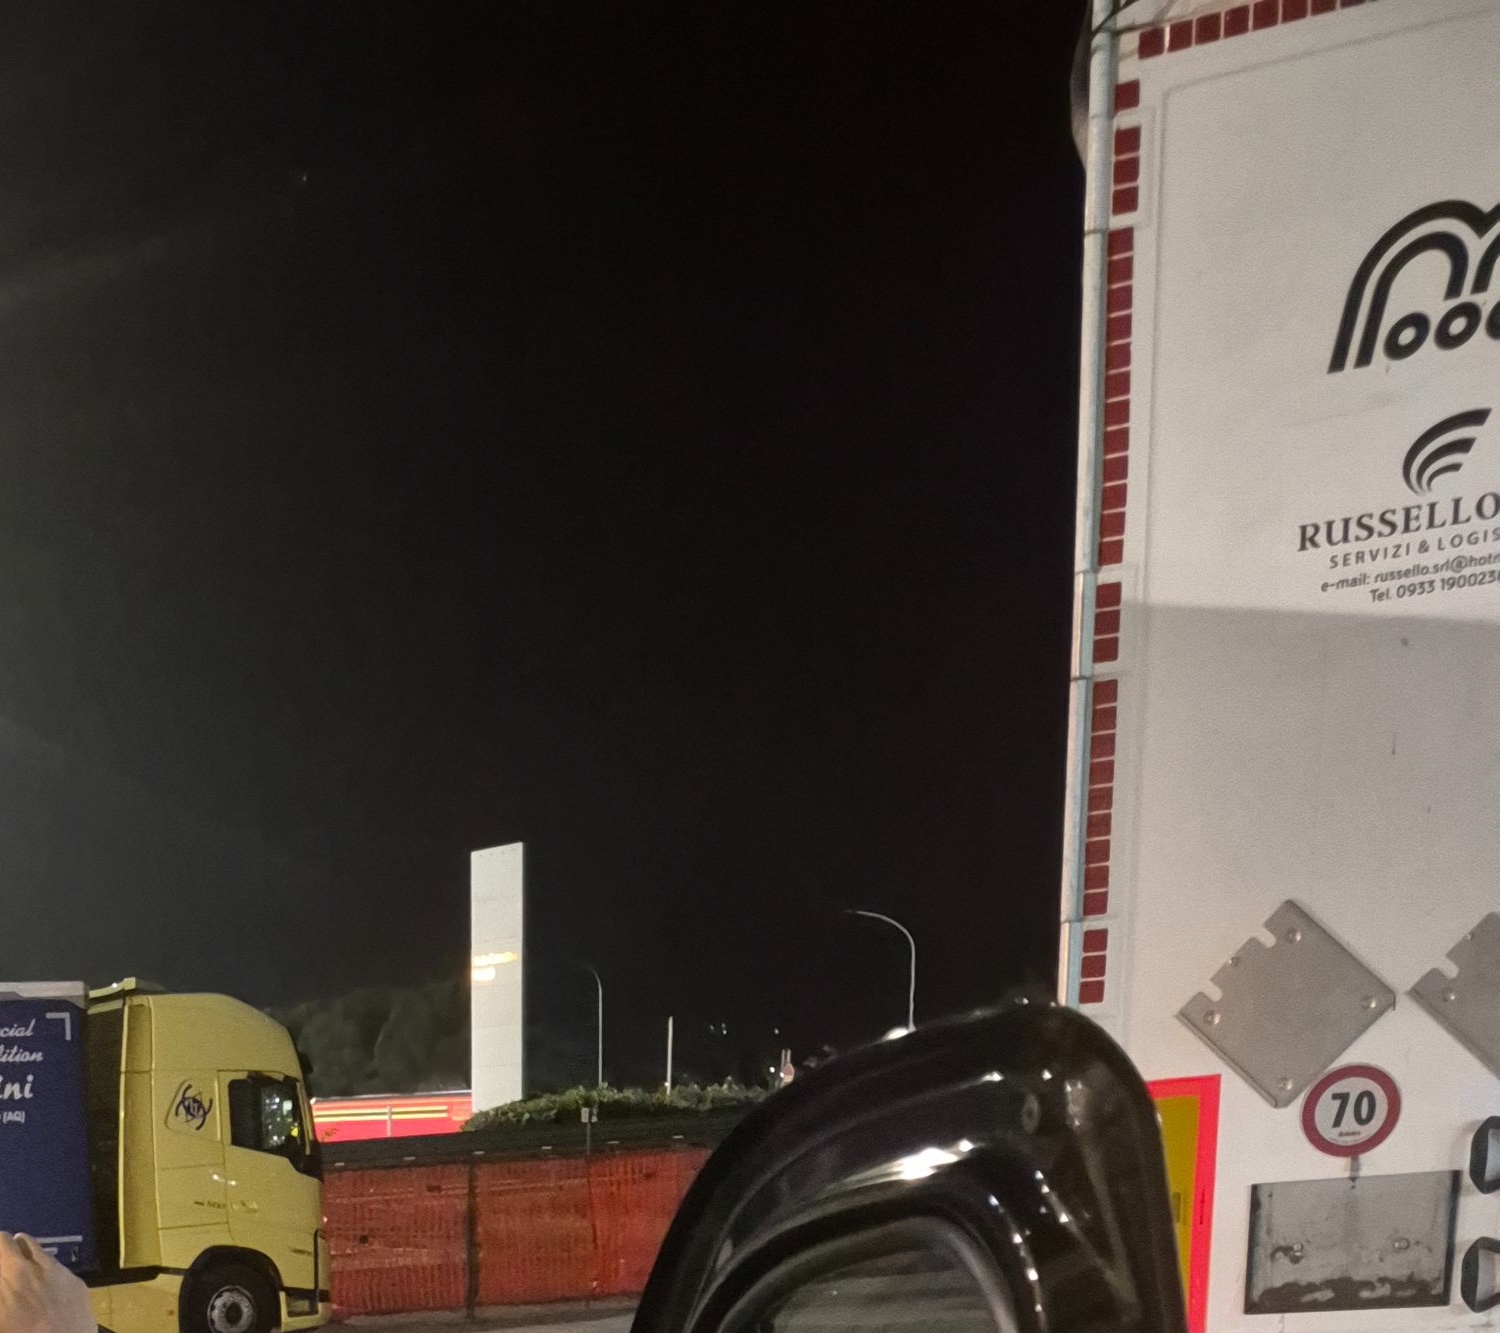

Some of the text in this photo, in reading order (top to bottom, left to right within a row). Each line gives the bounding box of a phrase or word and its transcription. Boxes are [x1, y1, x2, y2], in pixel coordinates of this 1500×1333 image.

[1297, 492, 1500, 552] RUSSELLO
[1329, 542, 1410, 569] SERVIZI
[1418, 539, 1430, 554] &
[1321, 572, 1370, 592] e-mail:
[1396, 580, 1436, 599] 0933
[1441, 570, 1500, 592] 190023
[1331, 1090, 1376, 1128] 70
